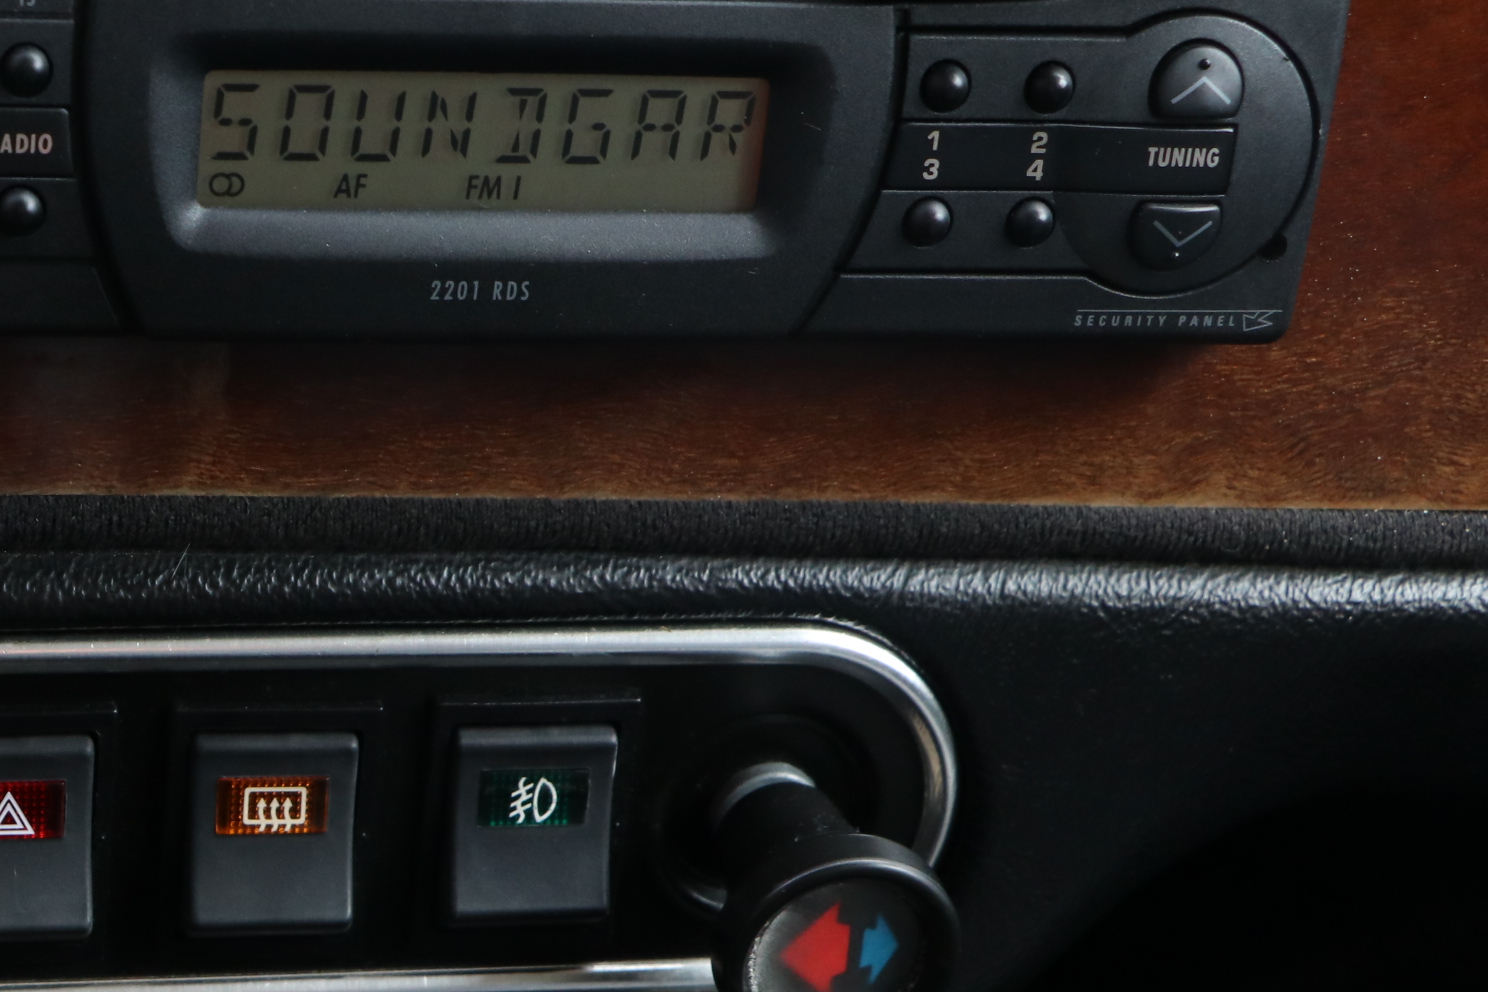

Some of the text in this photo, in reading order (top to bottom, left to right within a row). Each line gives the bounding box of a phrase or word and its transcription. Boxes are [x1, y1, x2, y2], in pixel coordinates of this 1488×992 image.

[212, 83, 756, 164] SOUNDGAR
[926, 130, 940, 151] 1
[1030, 131, 1048, 154] 2
[1147, 146, 1220, 168] TUNING
[922, 158, 939, 180] 3
[1026, 159, 1044, 181] 4
[333, 173, 368, 199] AF
[430, 280, 530, 301] 2201 RDS
[1073, 315, 1236, 327] SECURITY PANEL
